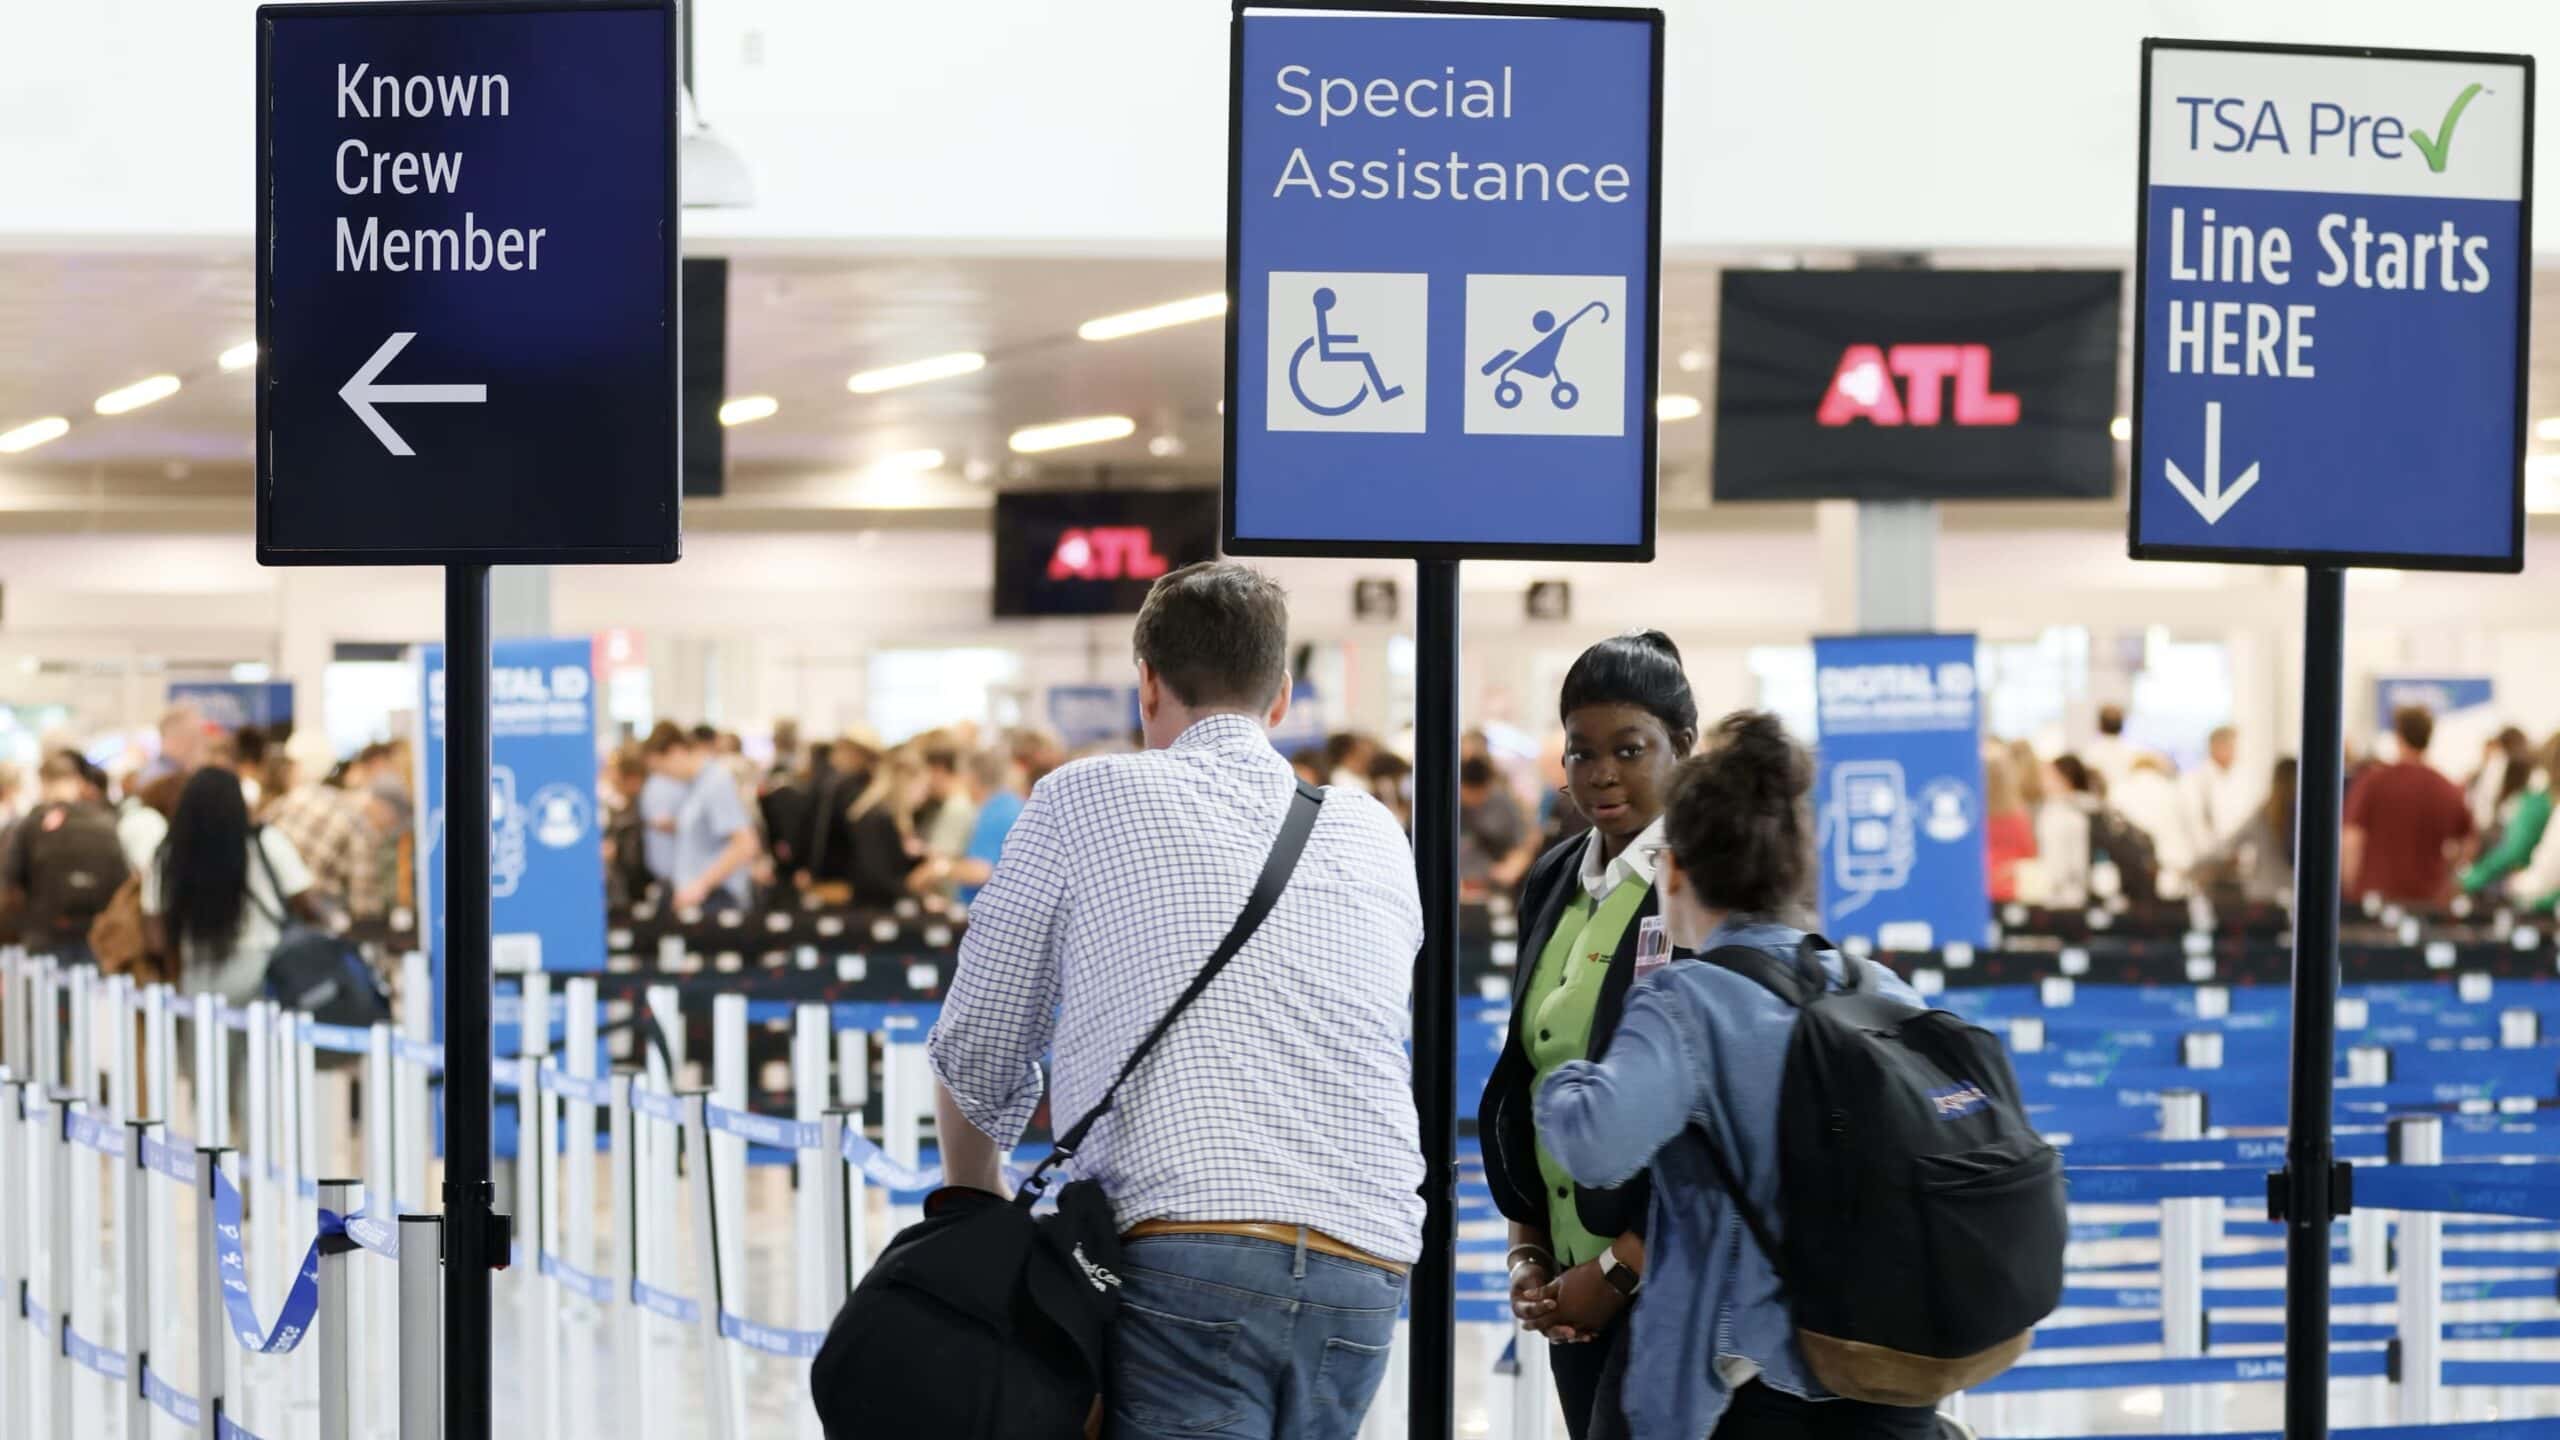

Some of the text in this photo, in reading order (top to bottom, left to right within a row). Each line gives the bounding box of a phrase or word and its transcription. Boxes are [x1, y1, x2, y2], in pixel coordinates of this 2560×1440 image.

[336, 63, 510, 118] Known
[1274, 64, 1513, 127] Special
[2175, 95, 2406, 160] TSA Pre
[335, 138, 463, 195] Crew
[1272, 147, 1631, 203] Assistance
[335, 211, 547, 272] Member
[2169, 207, 2491, 293] Line Starts
[2167, 300, 2316, 378] HERE
[1815, 344, 2021, 427] ATL
[1047, 526, 1168, 582] ATL
